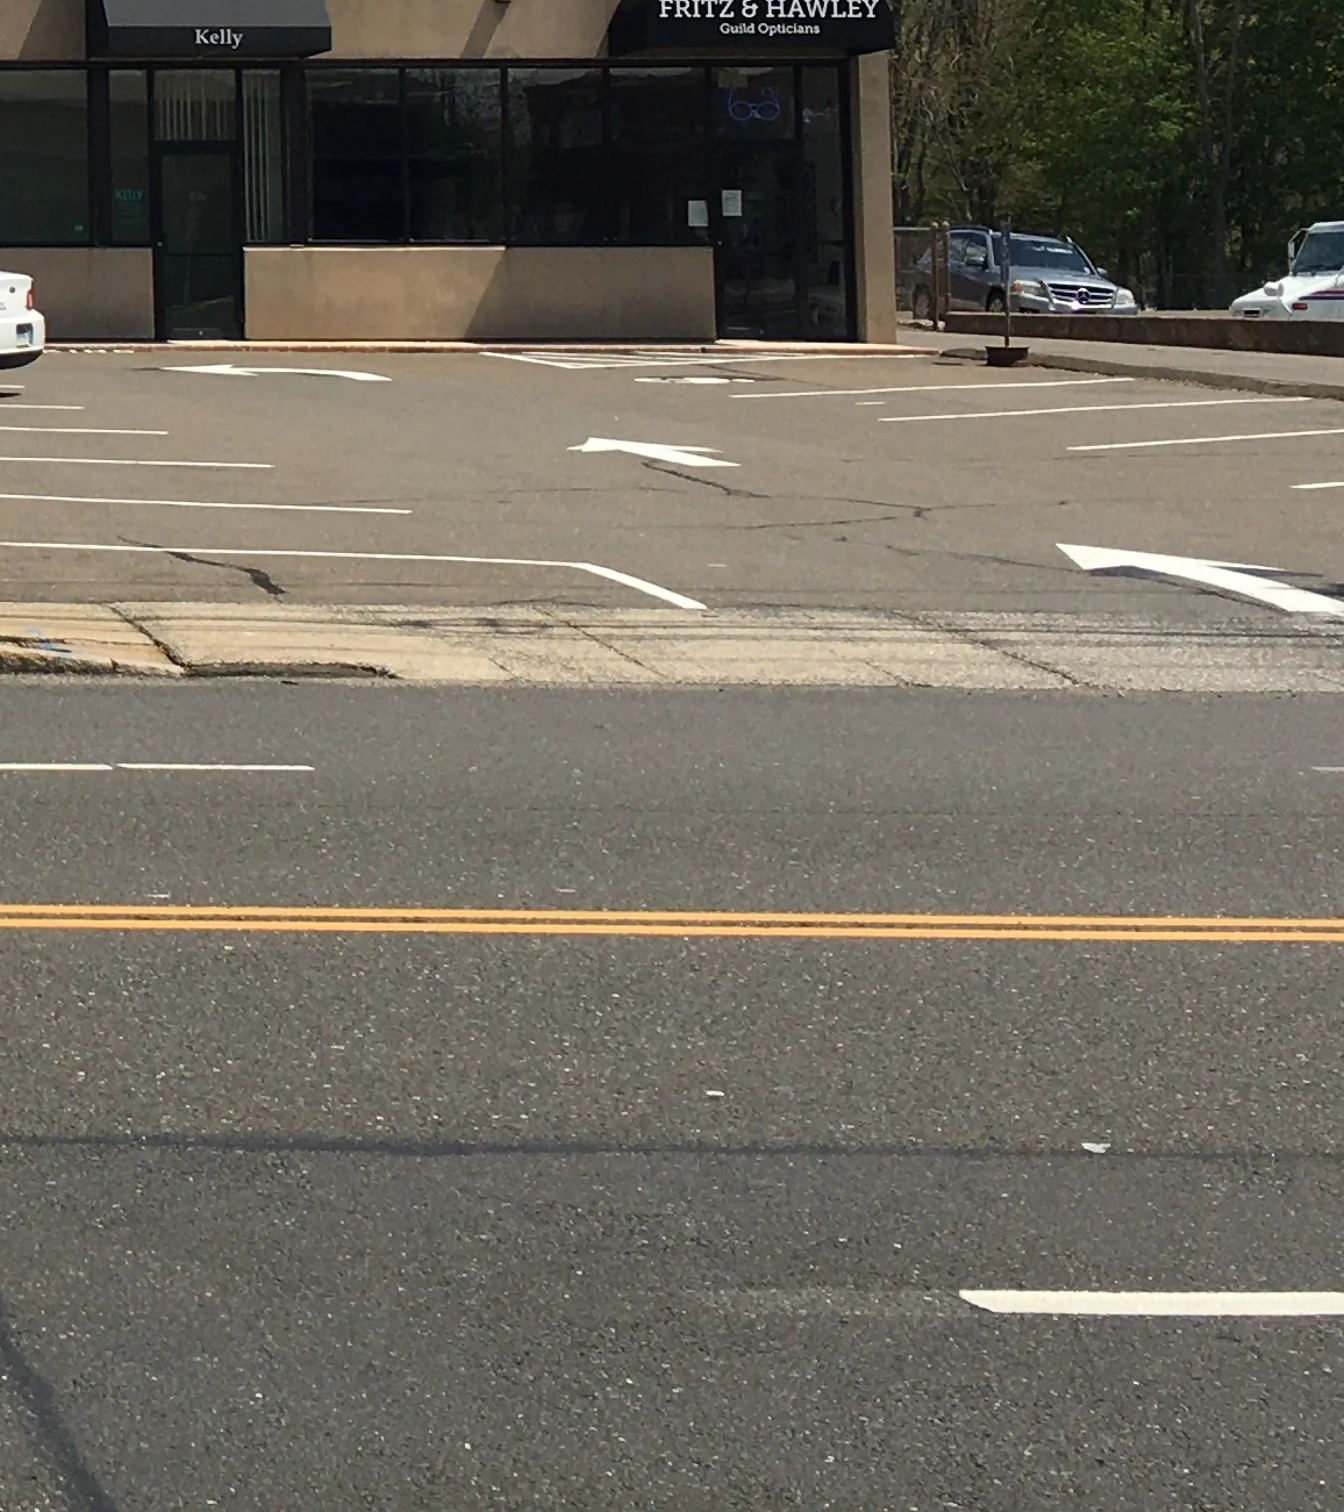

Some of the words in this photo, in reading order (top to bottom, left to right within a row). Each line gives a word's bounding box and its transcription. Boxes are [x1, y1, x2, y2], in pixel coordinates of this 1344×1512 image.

[719, 22, 755, 34] Guild
[757, 22, 820, 36] Opticians
[194, 28, 243, 50] Kelly
